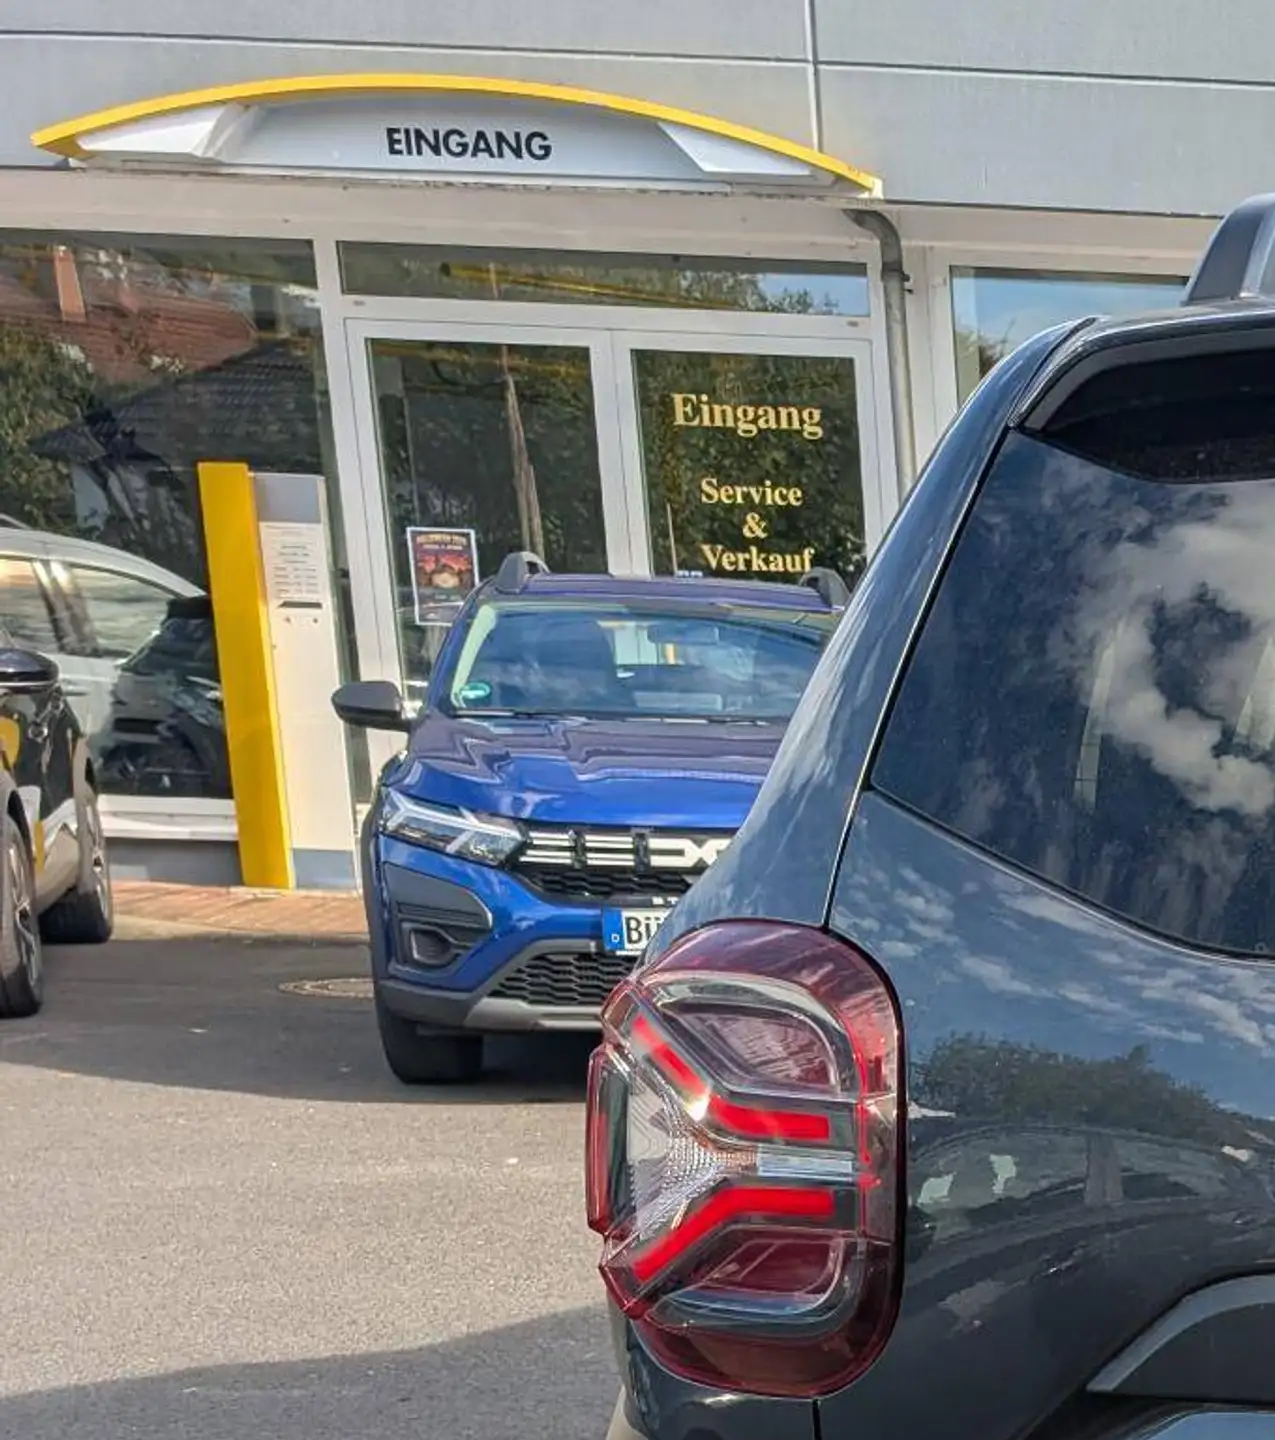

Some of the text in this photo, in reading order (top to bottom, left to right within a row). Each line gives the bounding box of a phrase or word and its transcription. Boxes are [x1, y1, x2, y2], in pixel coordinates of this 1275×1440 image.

[385, 127, 553, 161] EINGANG
[670, 393, 824, 440] Eingang
[701, 477, 803, 506] Service
[742, 512, 769, 539] &
[701, 543, 815, 573] Verkauf
